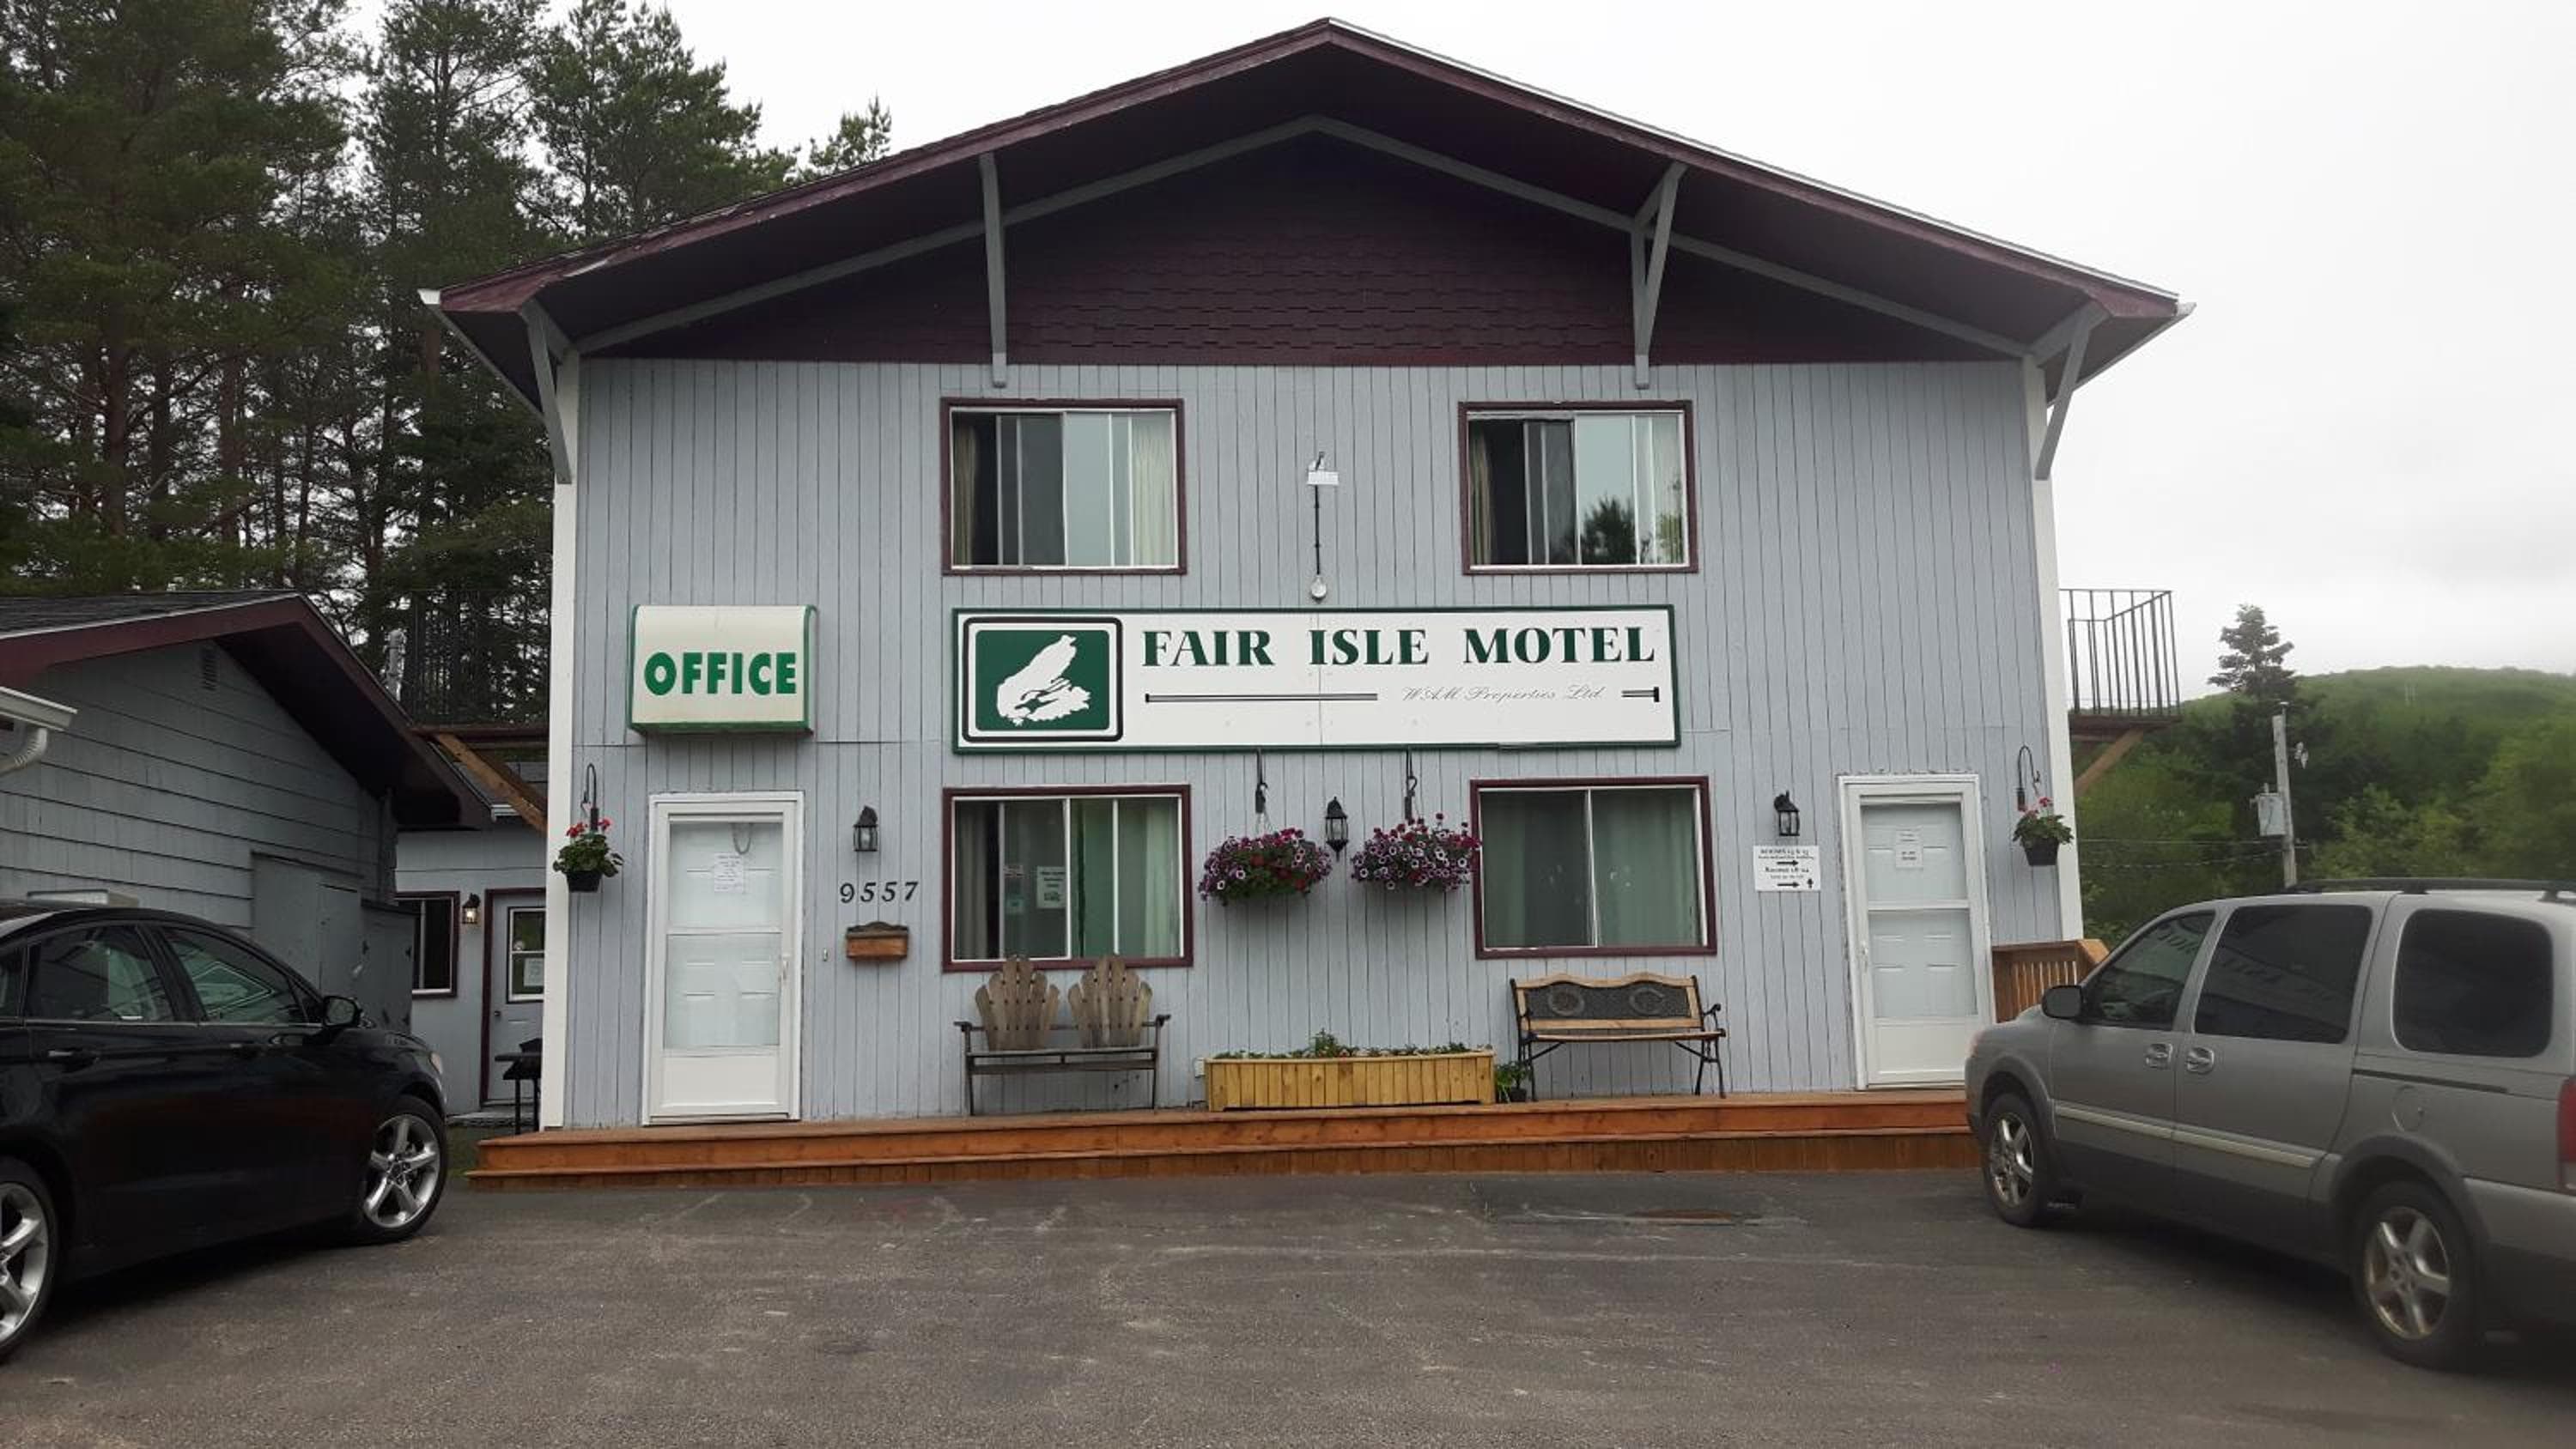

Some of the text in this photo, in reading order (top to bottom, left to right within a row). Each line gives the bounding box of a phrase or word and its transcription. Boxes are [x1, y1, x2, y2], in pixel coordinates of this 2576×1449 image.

[1142, 627, 1656, 666] FAIR ISLE MOTEL
[644, 652, 797, 695] OFFICE
[1465, 686, 1557, 704] Properties
[1564, 684, 1607, 701] Ltd
[840, 881, 919, 904] 9557
